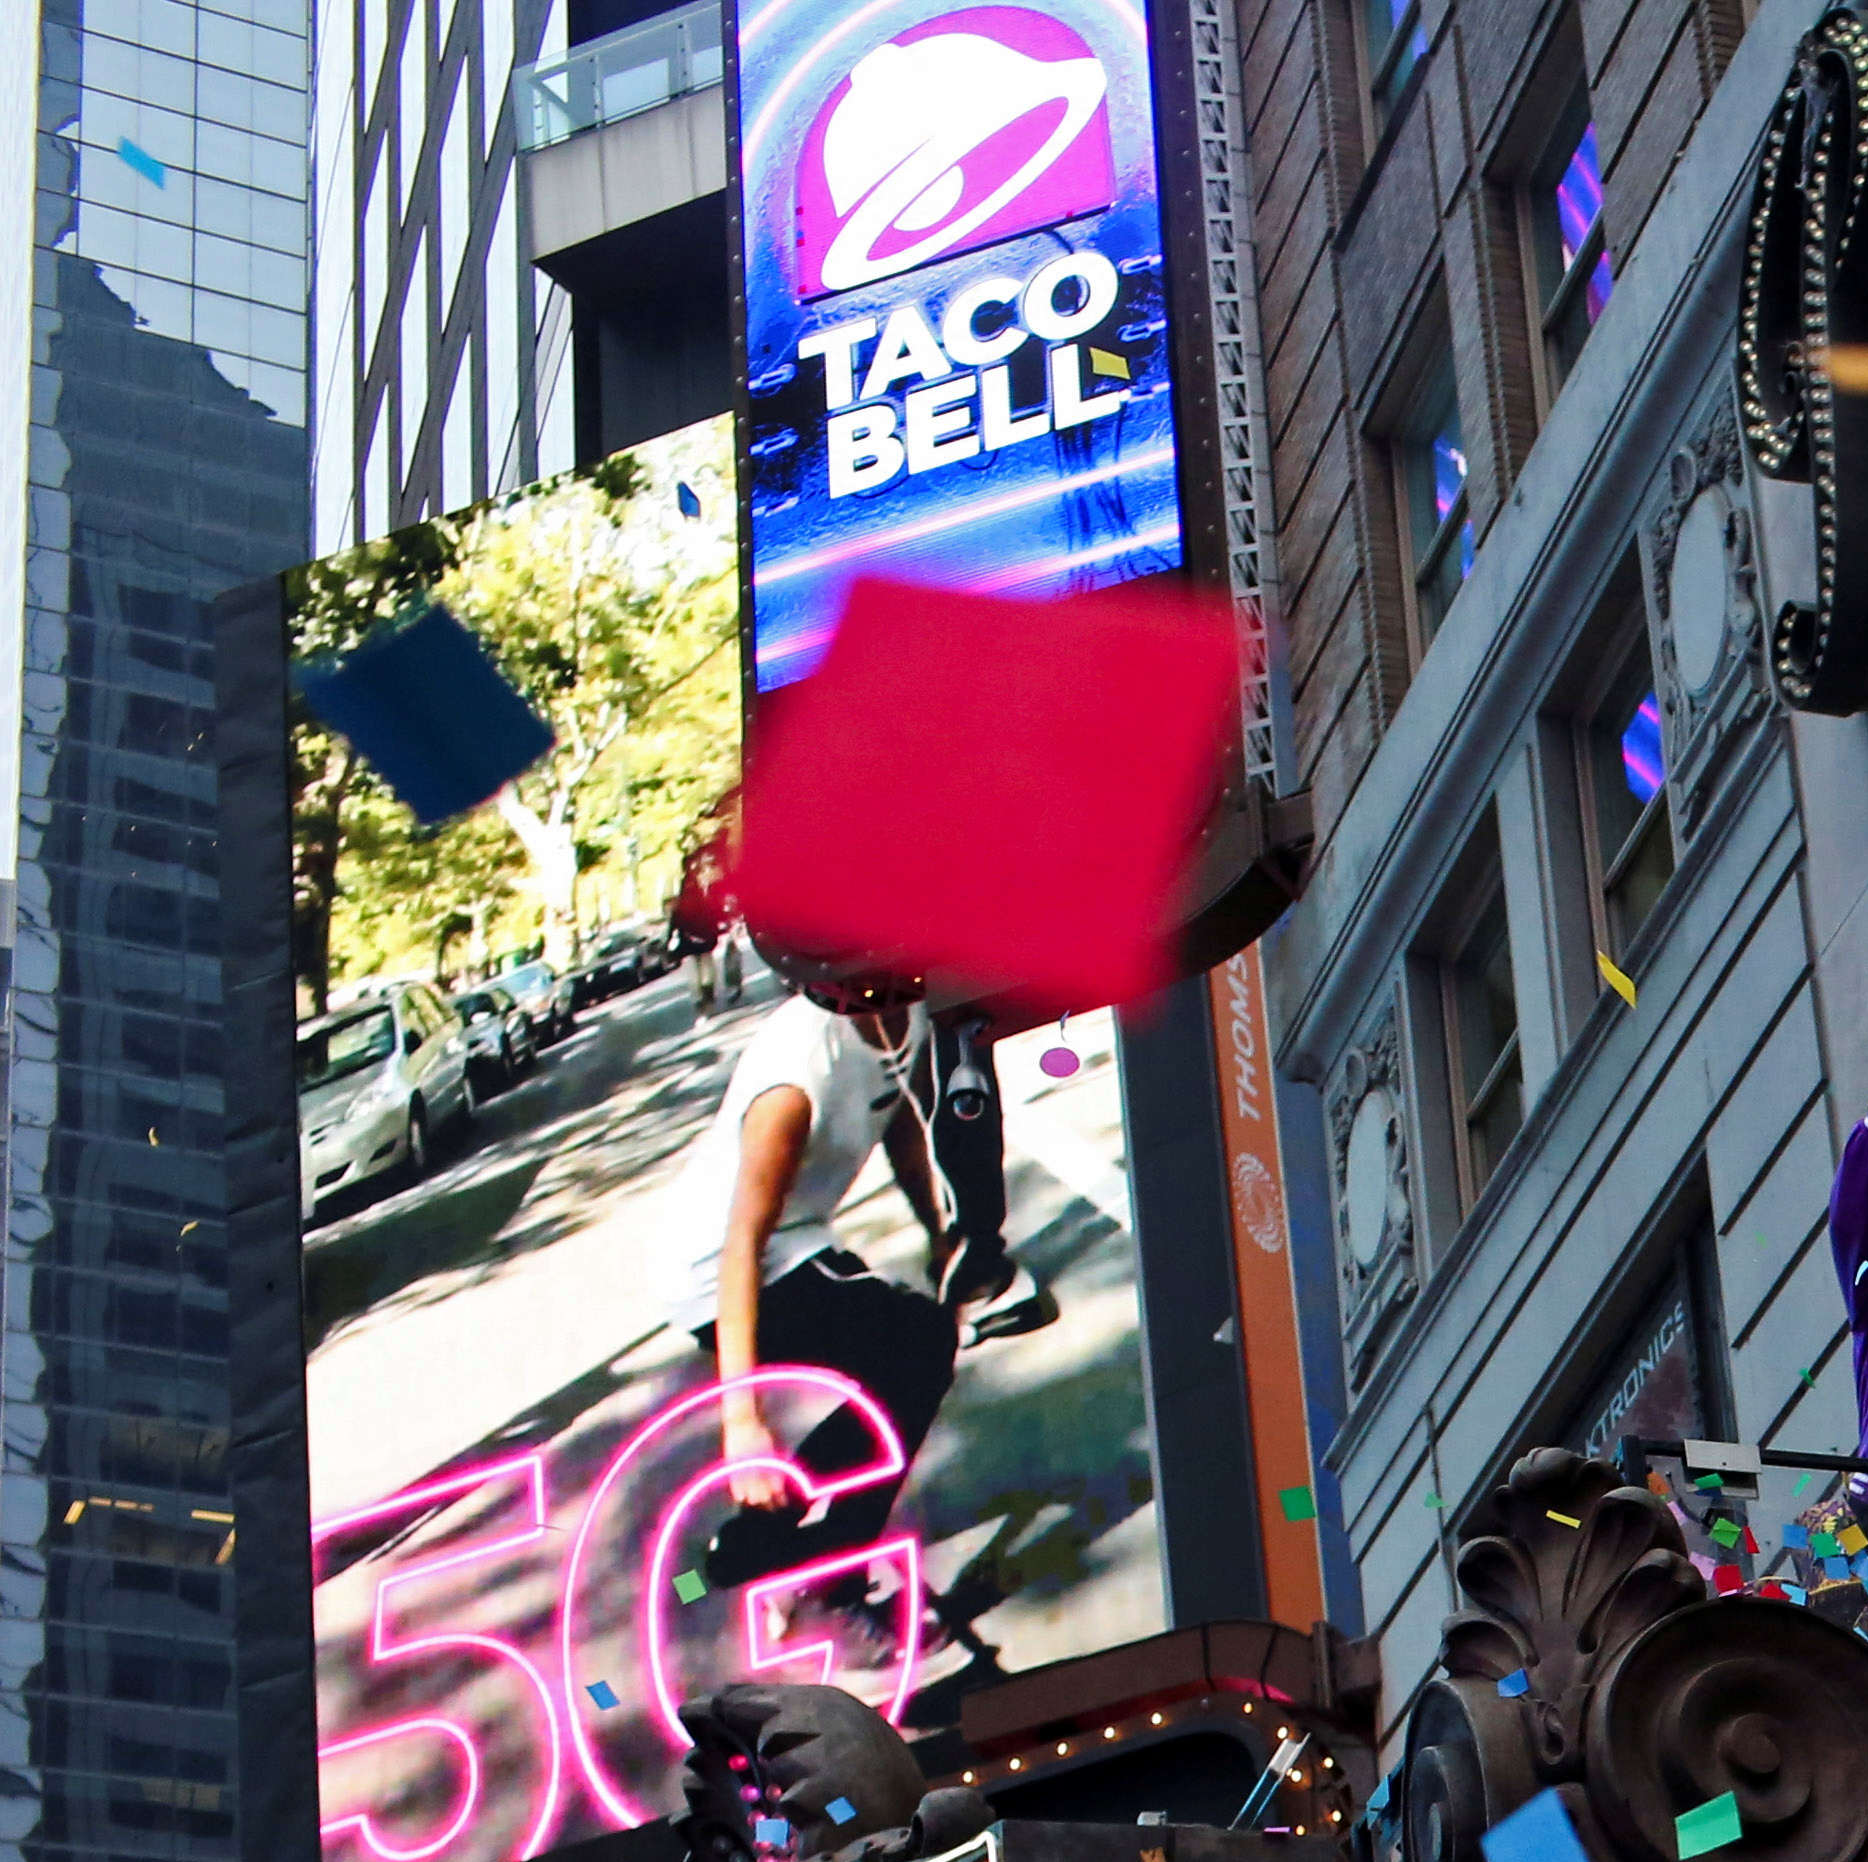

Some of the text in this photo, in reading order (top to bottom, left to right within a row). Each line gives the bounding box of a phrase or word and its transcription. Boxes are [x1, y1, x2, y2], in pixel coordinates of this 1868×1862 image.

[798, 248, 1119, 407] TACO
[827, 344, 1127, 500] BELL
[311, 1366, 920, 1862] 5G
